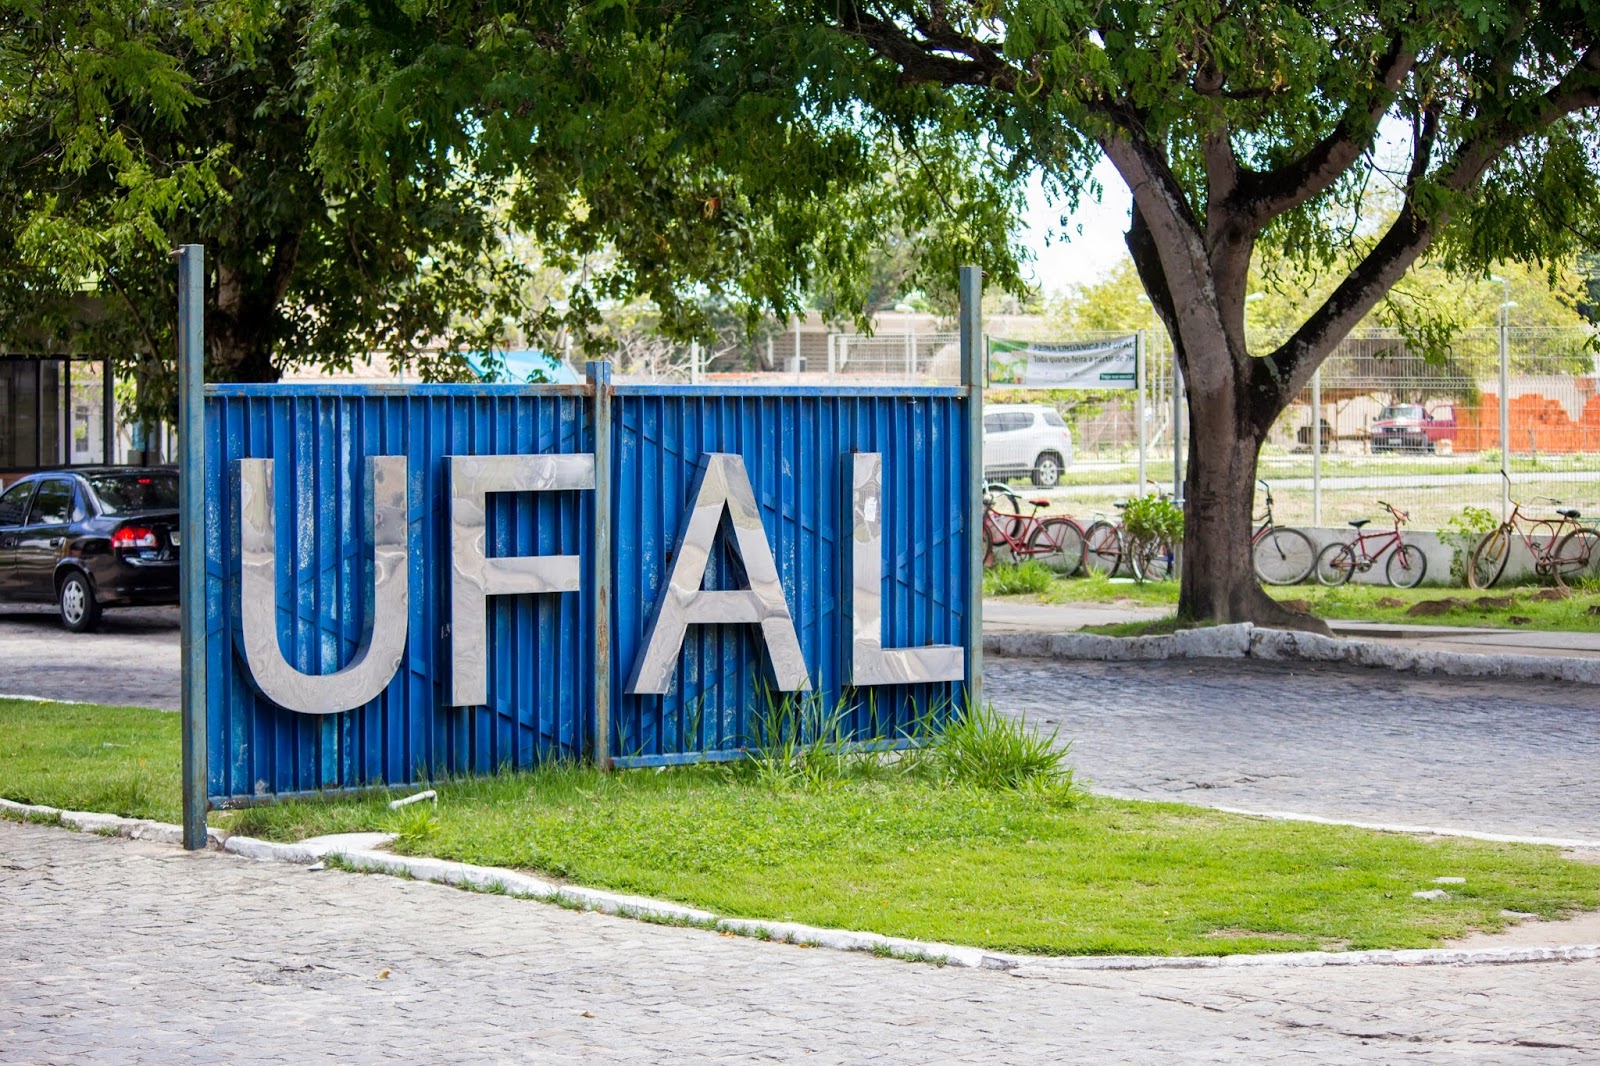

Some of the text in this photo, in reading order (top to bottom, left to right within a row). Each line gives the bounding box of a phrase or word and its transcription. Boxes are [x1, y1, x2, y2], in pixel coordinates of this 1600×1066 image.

[1033, 355, 1048, 363] Toda
[1049, 355, 1087, 364] quarta-feira
[1095, 354, 1114, 365] partir
[1116, 354, 1124, 362] de
[235, 451, 965, 715] UFAL
